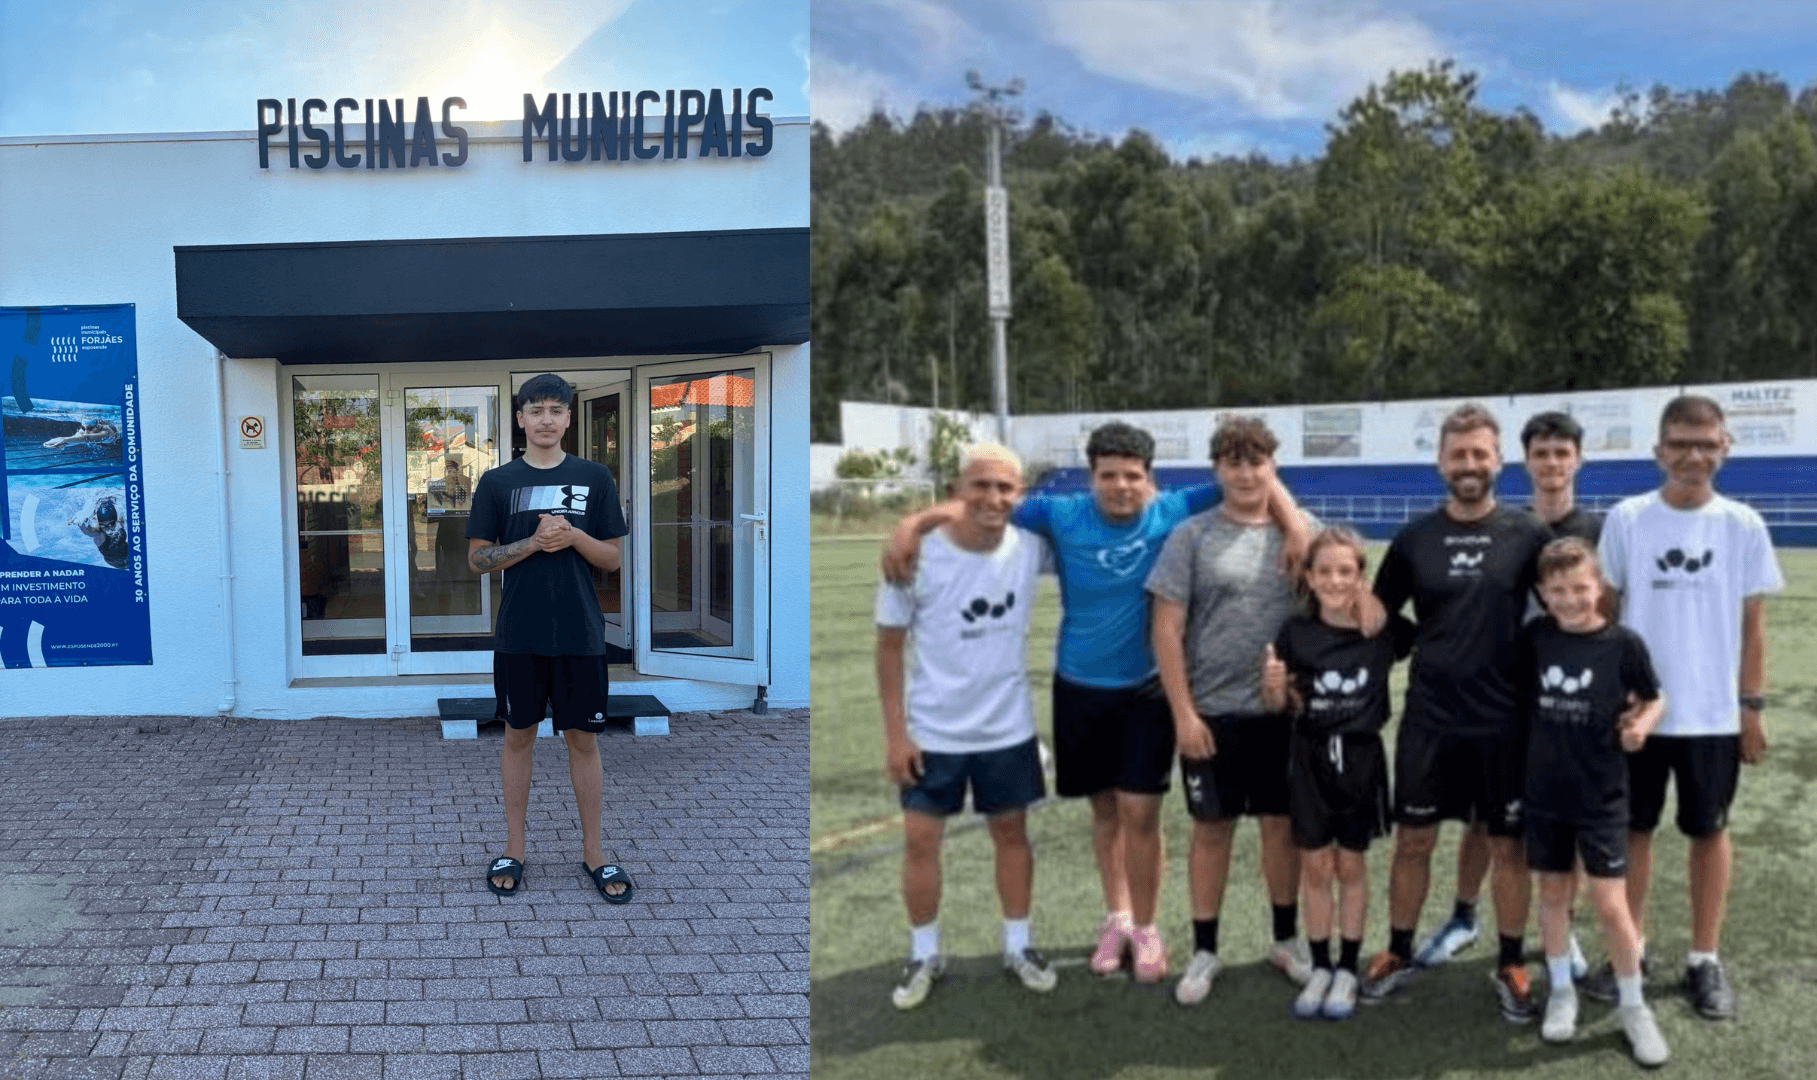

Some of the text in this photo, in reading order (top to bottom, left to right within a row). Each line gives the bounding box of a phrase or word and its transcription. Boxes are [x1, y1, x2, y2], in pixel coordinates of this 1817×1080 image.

[257, 87, 773, 169] PISCINAS MUNICIPAIS
[125, 383, 144, 603] 30 ANOS AO SERVIÇO DA COMUNIDADE
[0, 570, 41, 578] PRENDER
[52, 569, 85, 577] NADAR
[0, 581, 86, 592] M INVESTIMENTO
[0, 594, 89, 605] ARA TODA A VIDA
[497, 858, 514, 866] NIKE
[603, 866, 617, 874] NIKE
